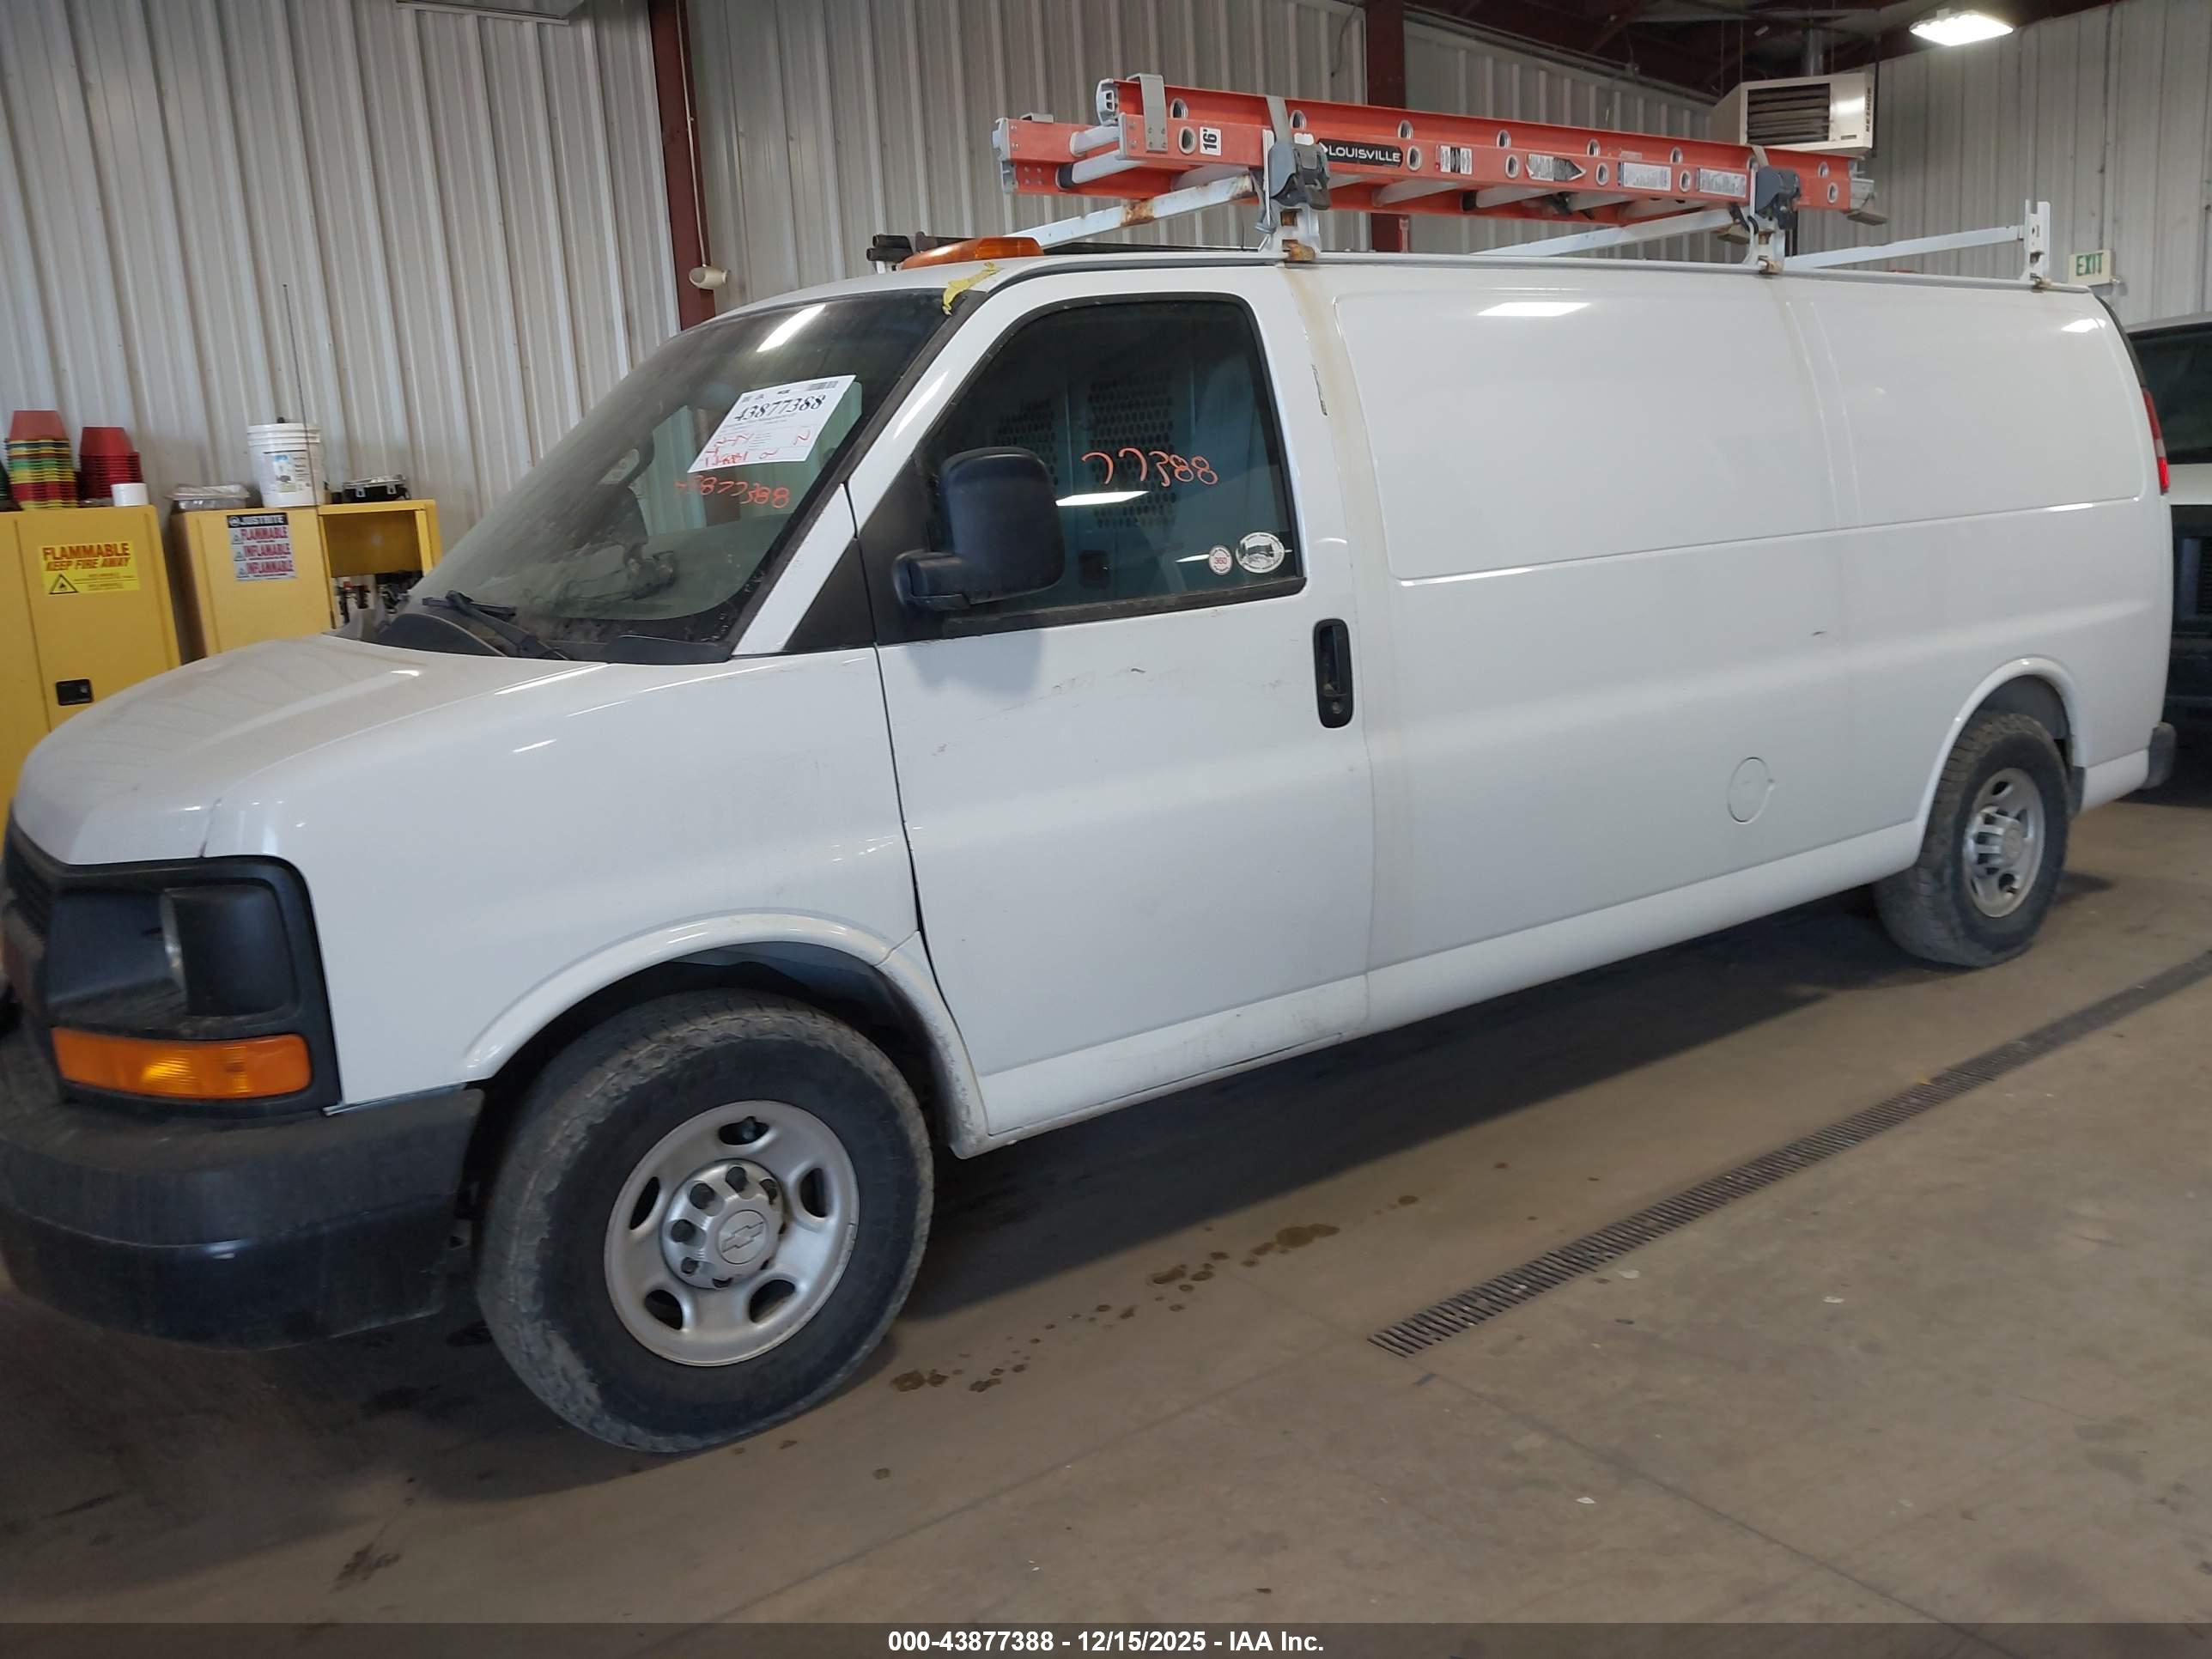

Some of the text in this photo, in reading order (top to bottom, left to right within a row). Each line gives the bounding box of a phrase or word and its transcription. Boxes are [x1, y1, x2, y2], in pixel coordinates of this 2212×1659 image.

[1202, 129, 1218, 150] 16'
[1328, 144, 1401, 162] LOUISVILLE
[2075, 252, 2103, 276] EXIT
[733, 393, 827, 422] 43877388
[1081, 447, 1219, 487] 77388
[240, 514, 284, 526] JUSTRITE
[240, 526, 289, 541] FLAMMABLE
[42, 542, 131, 561] FLAMMABLE
[46, 556, 131, 572] KEEP FIRE AWAY
